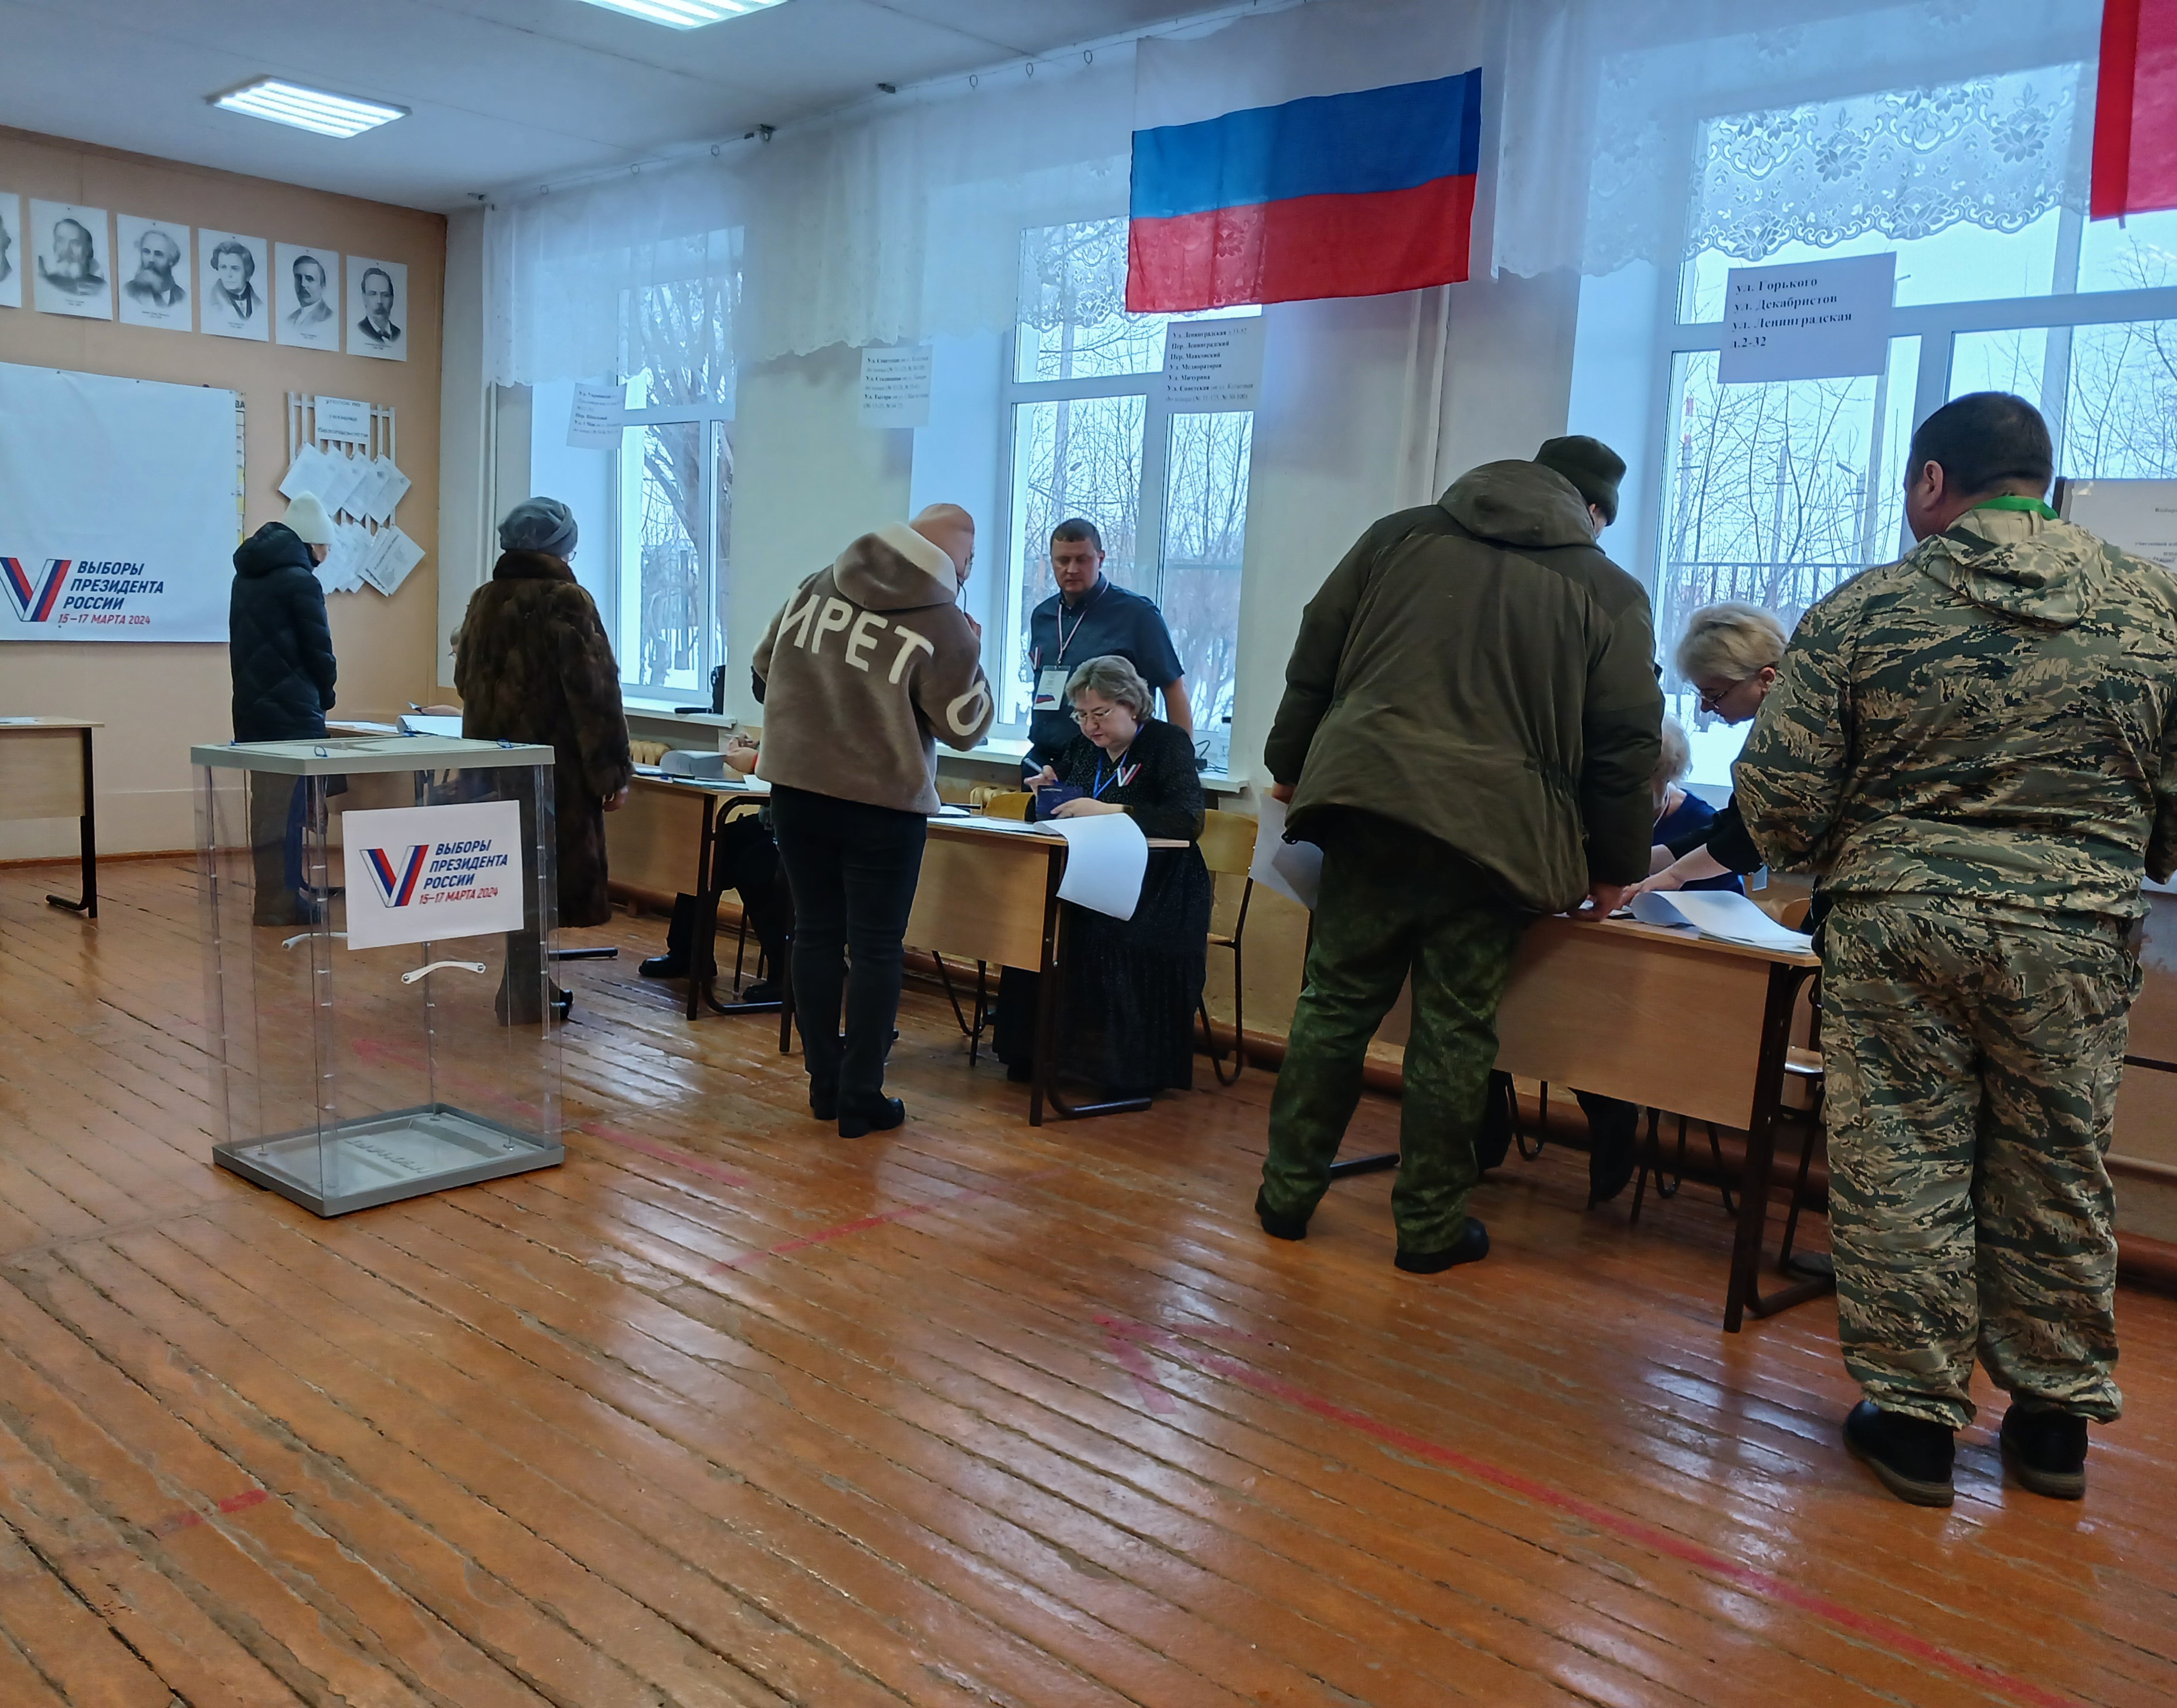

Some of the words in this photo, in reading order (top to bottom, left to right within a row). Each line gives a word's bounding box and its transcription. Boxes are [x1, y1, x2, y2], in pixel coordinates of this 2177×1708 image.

[1736, 284, 1754, 295] ул.
[1759, 279, 1817, 293] Горького
[1734, 302, 1752, 314] ул.
[1755, 296, 1838, 311] Декабристов
[1732, 322, 1750, 332] ул.
[1754, 313, 1852, 328] Ленинградская
[1730, 336, 1766, 349] д.2-32
[77, 561, 144, 575] ВЫБОРЫ
[70, 578, 164, 594] ПРЕЗИДЕНТА
[63, 596, 124, 610] РОССИИ
[91, 614, 125, 624] МАРТА
[128, 616, 150, 624] 2024
[435, 840, 491, 855] ВЫБОРЫ
[429, 854, 508, 872] ПРЕЗИДЕНТА
[423, 873, 475, 889] РОССИИ
[445, 889, 476, 902] МАРТА
[477, 887, 498, 898] 2024
